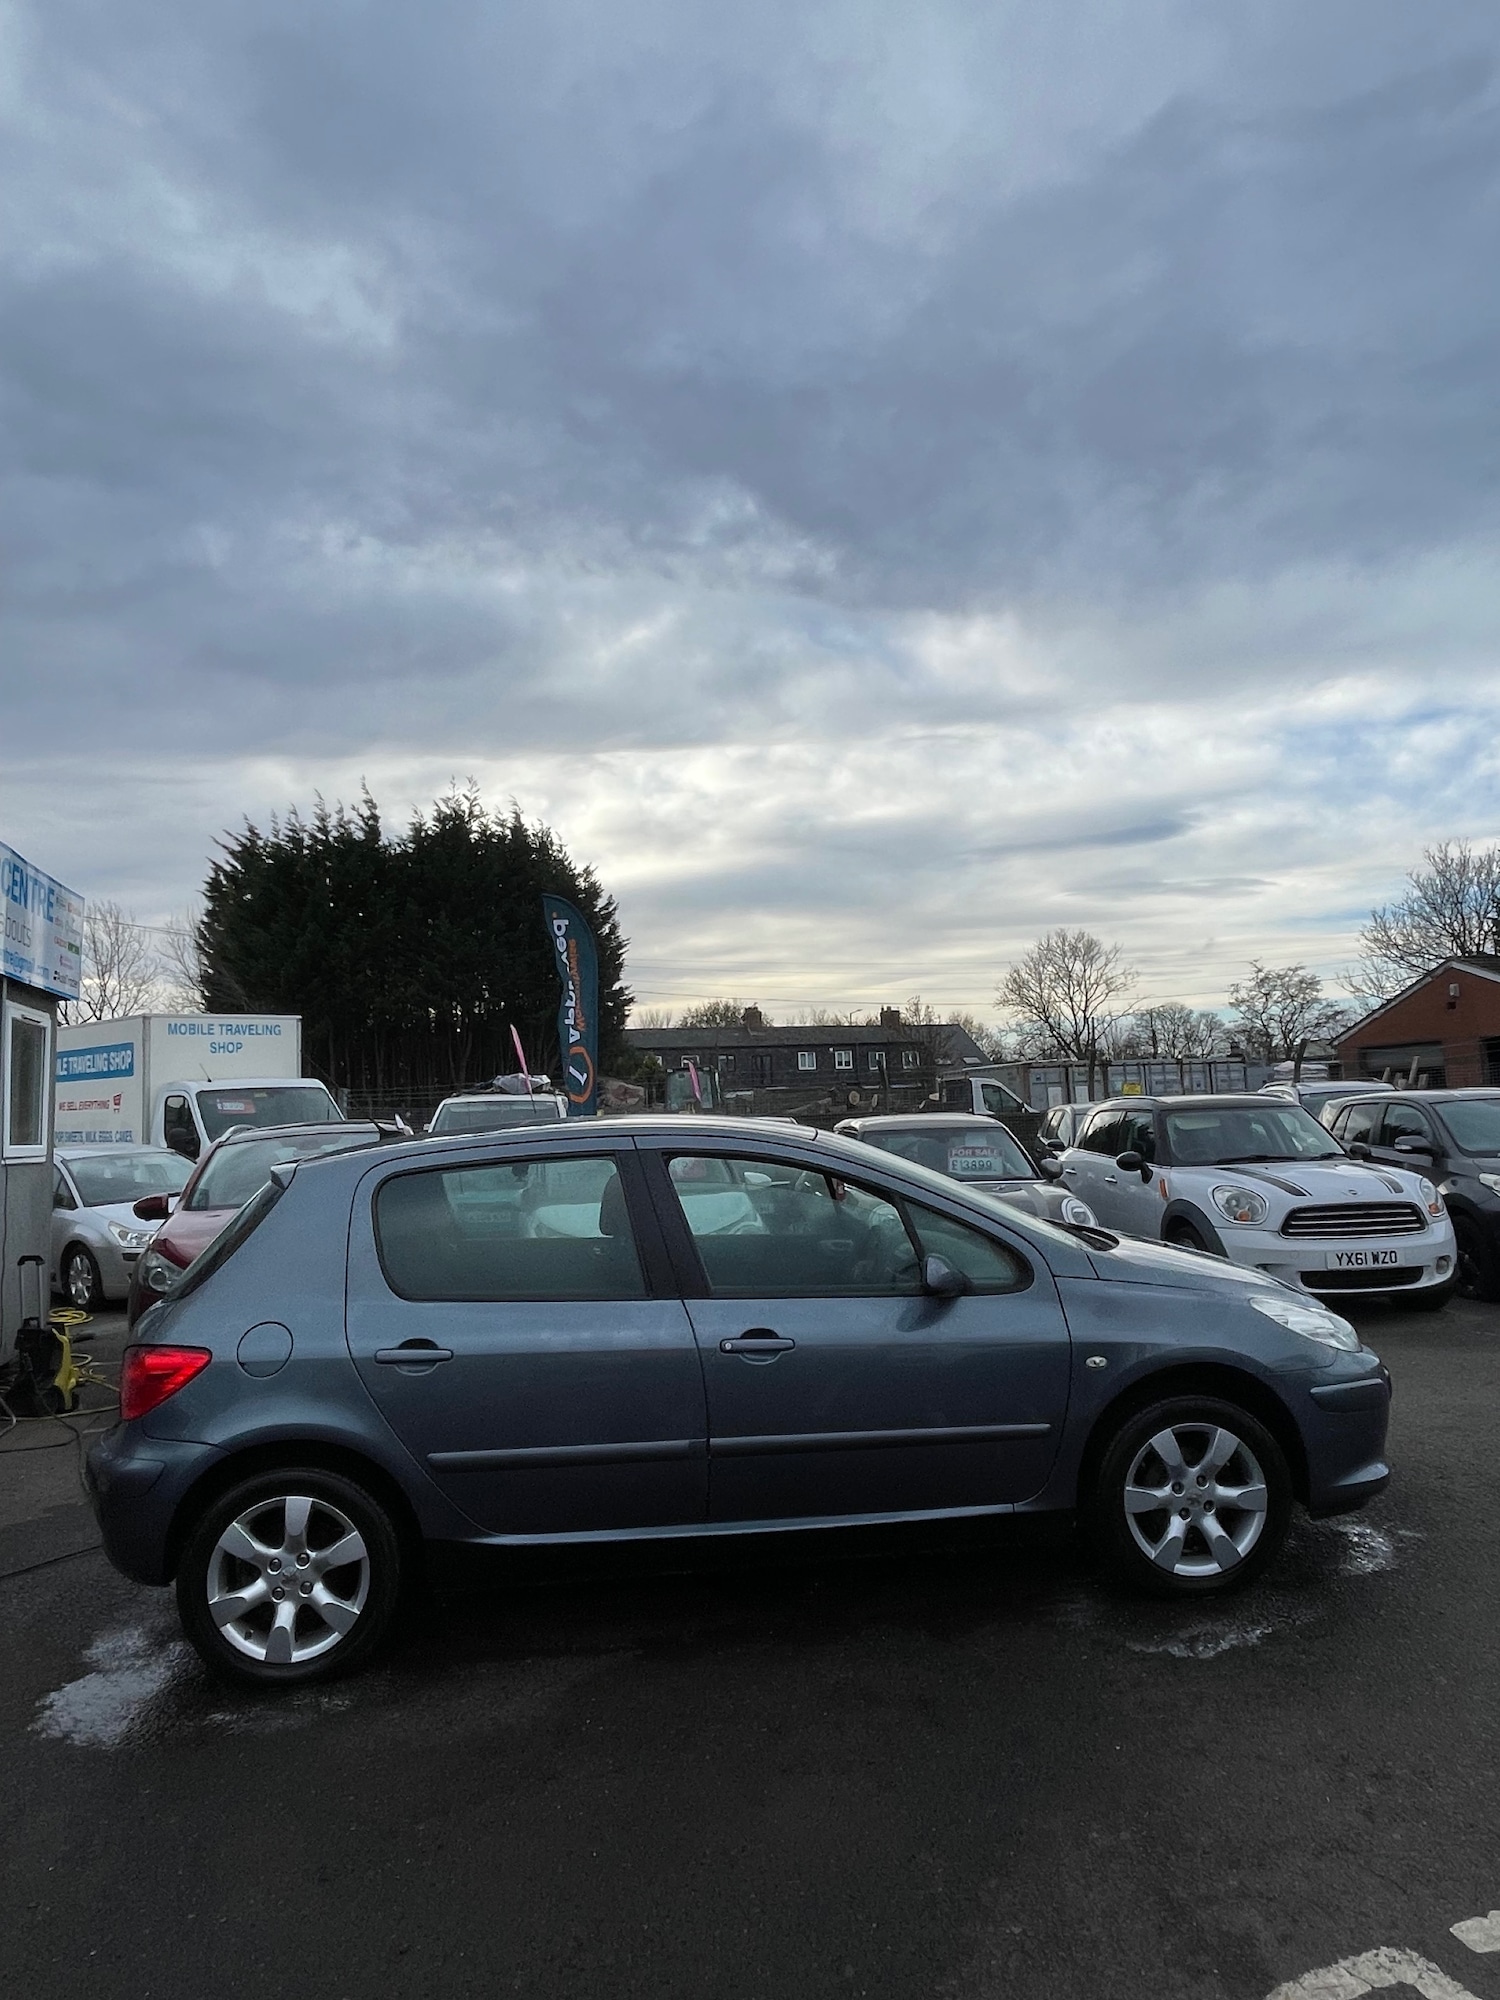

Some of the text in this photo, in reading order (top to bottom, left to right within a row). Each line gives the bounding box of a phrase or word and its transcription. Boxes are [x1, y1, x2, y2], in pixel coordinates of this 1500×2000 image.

[1, 857, 55, 923] CENTRE
[167, 1023, 281, 1036] MOBILE TRAVELING
[209, 1042, 243, 1054] SHOP
[68, 1053, 108, 1074] TRAVELING
[109, 1050, 132, 1071] SHOP
[66, 1101, 77, 1111] SELL
[78, 1099, 110, 1111] EVERYTHING
[1335, 1250, 1398, 1266] YX61 WZO
